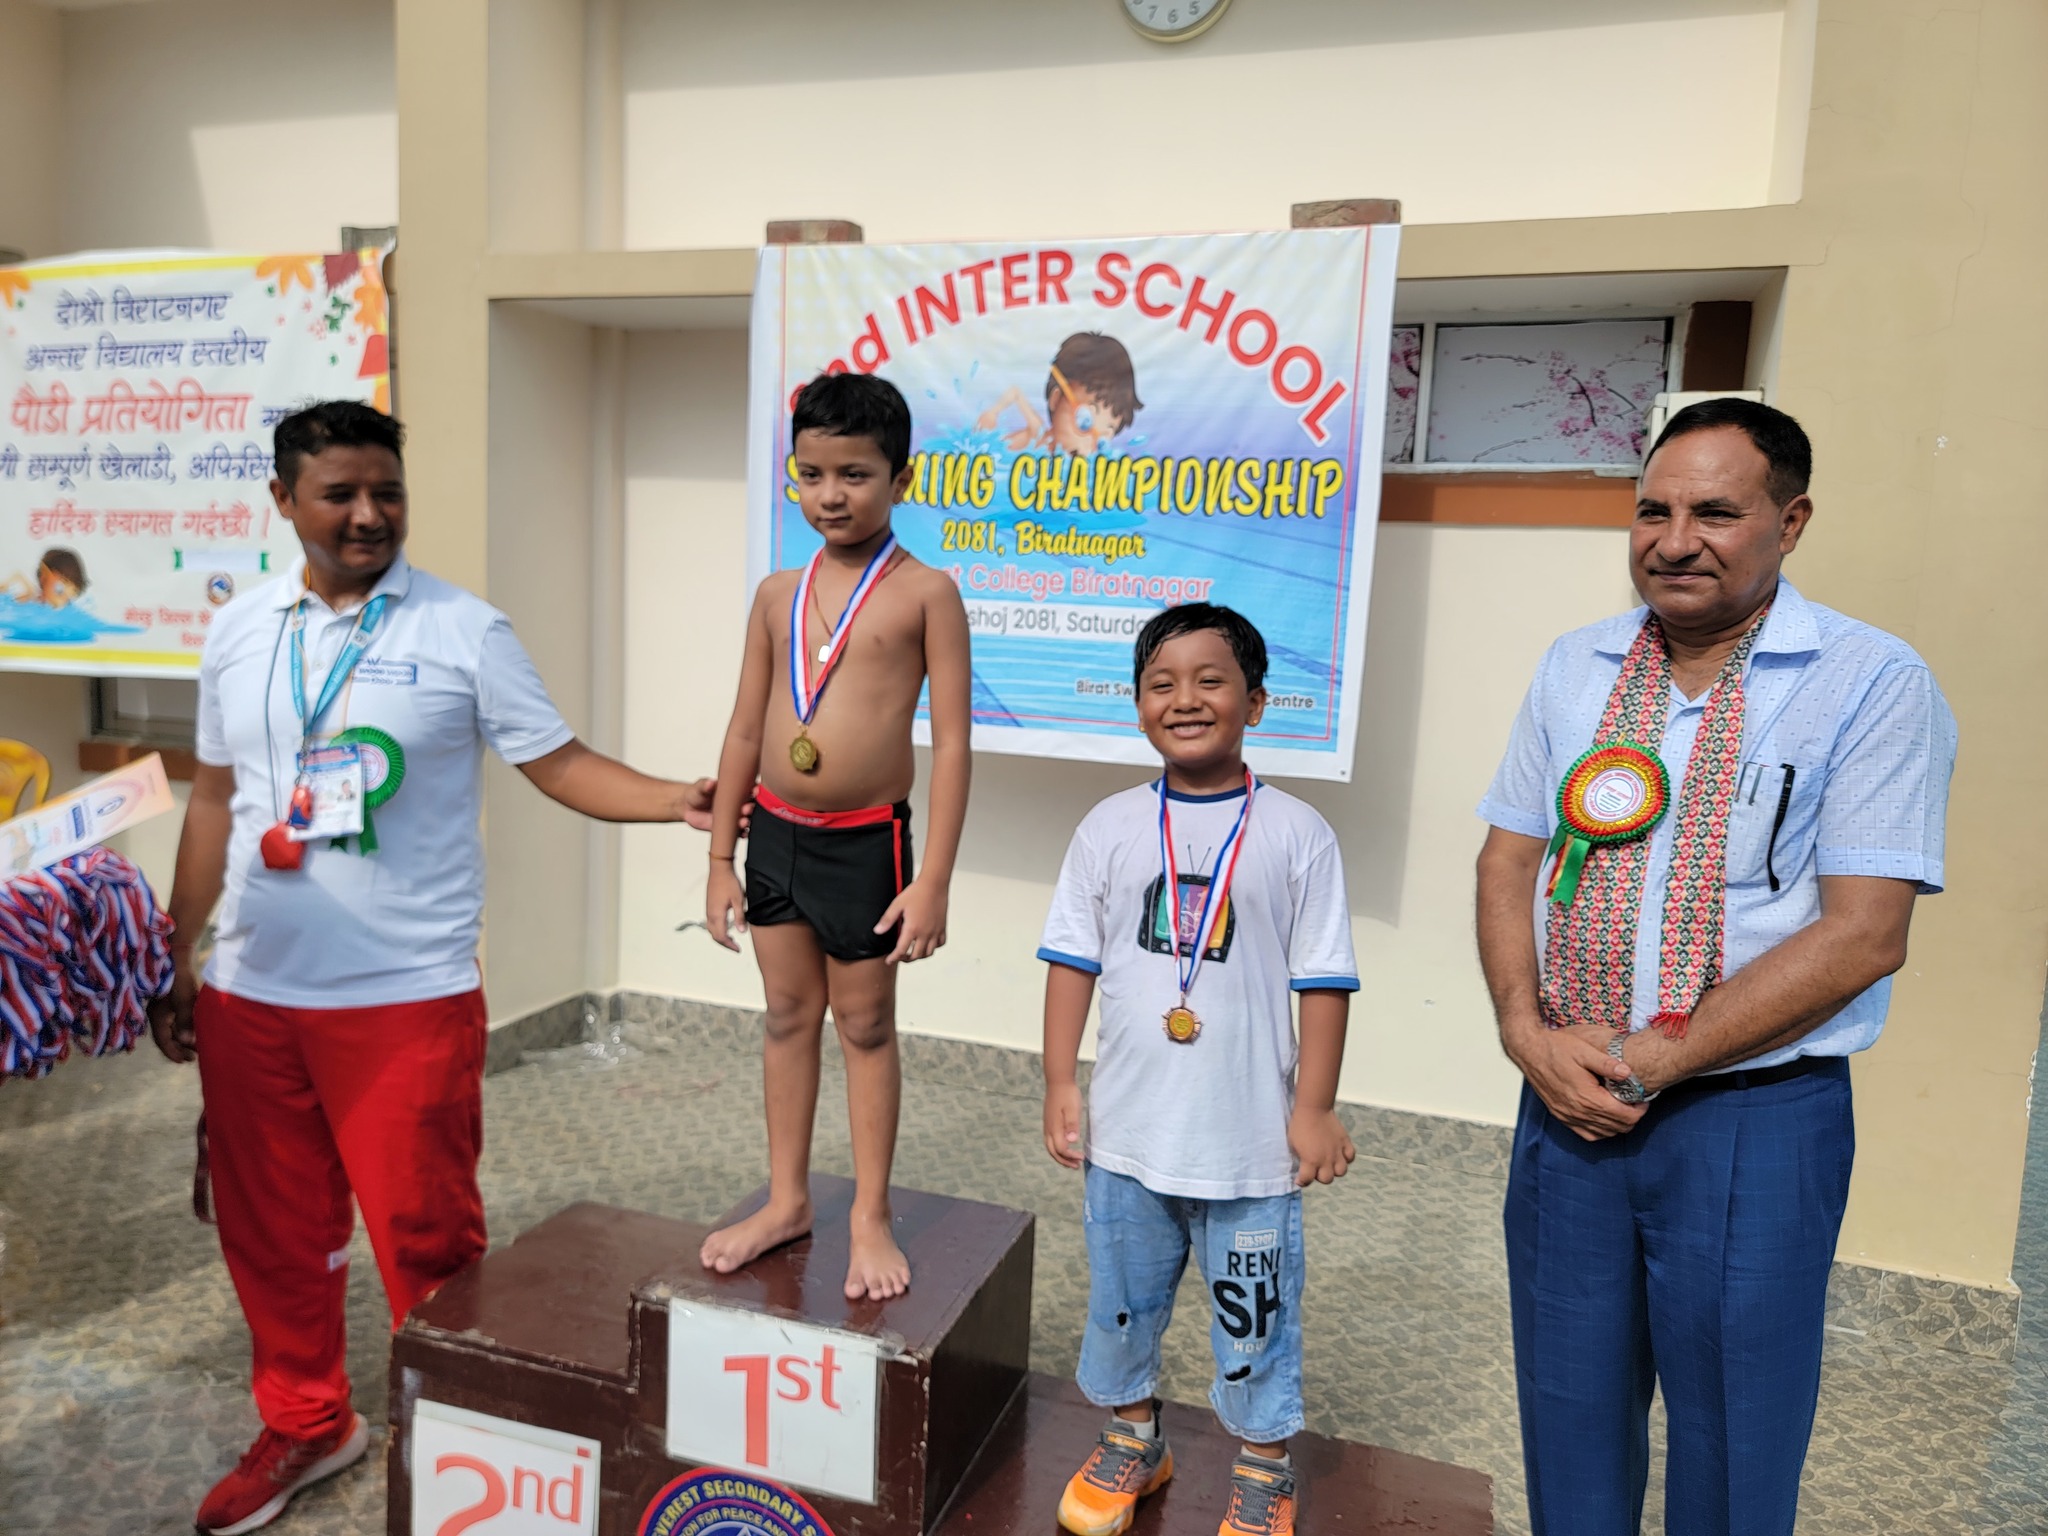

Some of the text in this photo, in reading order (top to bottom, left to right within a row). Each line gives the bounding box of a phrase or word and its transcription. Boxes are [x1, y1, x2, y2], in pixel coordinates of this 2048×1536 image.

[1167, 8, 1179, 24] 6
[1188, 1, 1200, 16] 5
[896, 250, 1349, 442] INTER SCHOOL
[79, 377, 254, 436] प्रतियोगिता
[1009, 453, 1345, 519] CHAMPIONSHIP
[942, 519, 1147, 565] 2081, Biratnagar
[968, 565, 1065, 601] College
[1071, 568, 1213, 607] Biratnagar
[967, 605, 1151, 636] shoj 2081, Saturd
[1076, 680, 1110, 695] Birat
[723, 1345, 842, 1467] 1st
[435, 1448, 592, 1536] 2nd
[653, 1479, 804, 1536] VEREST SECONDARY
[698, 1508, 721, 1528] FOR
[721, 1507, 763, 1525] PEACE
